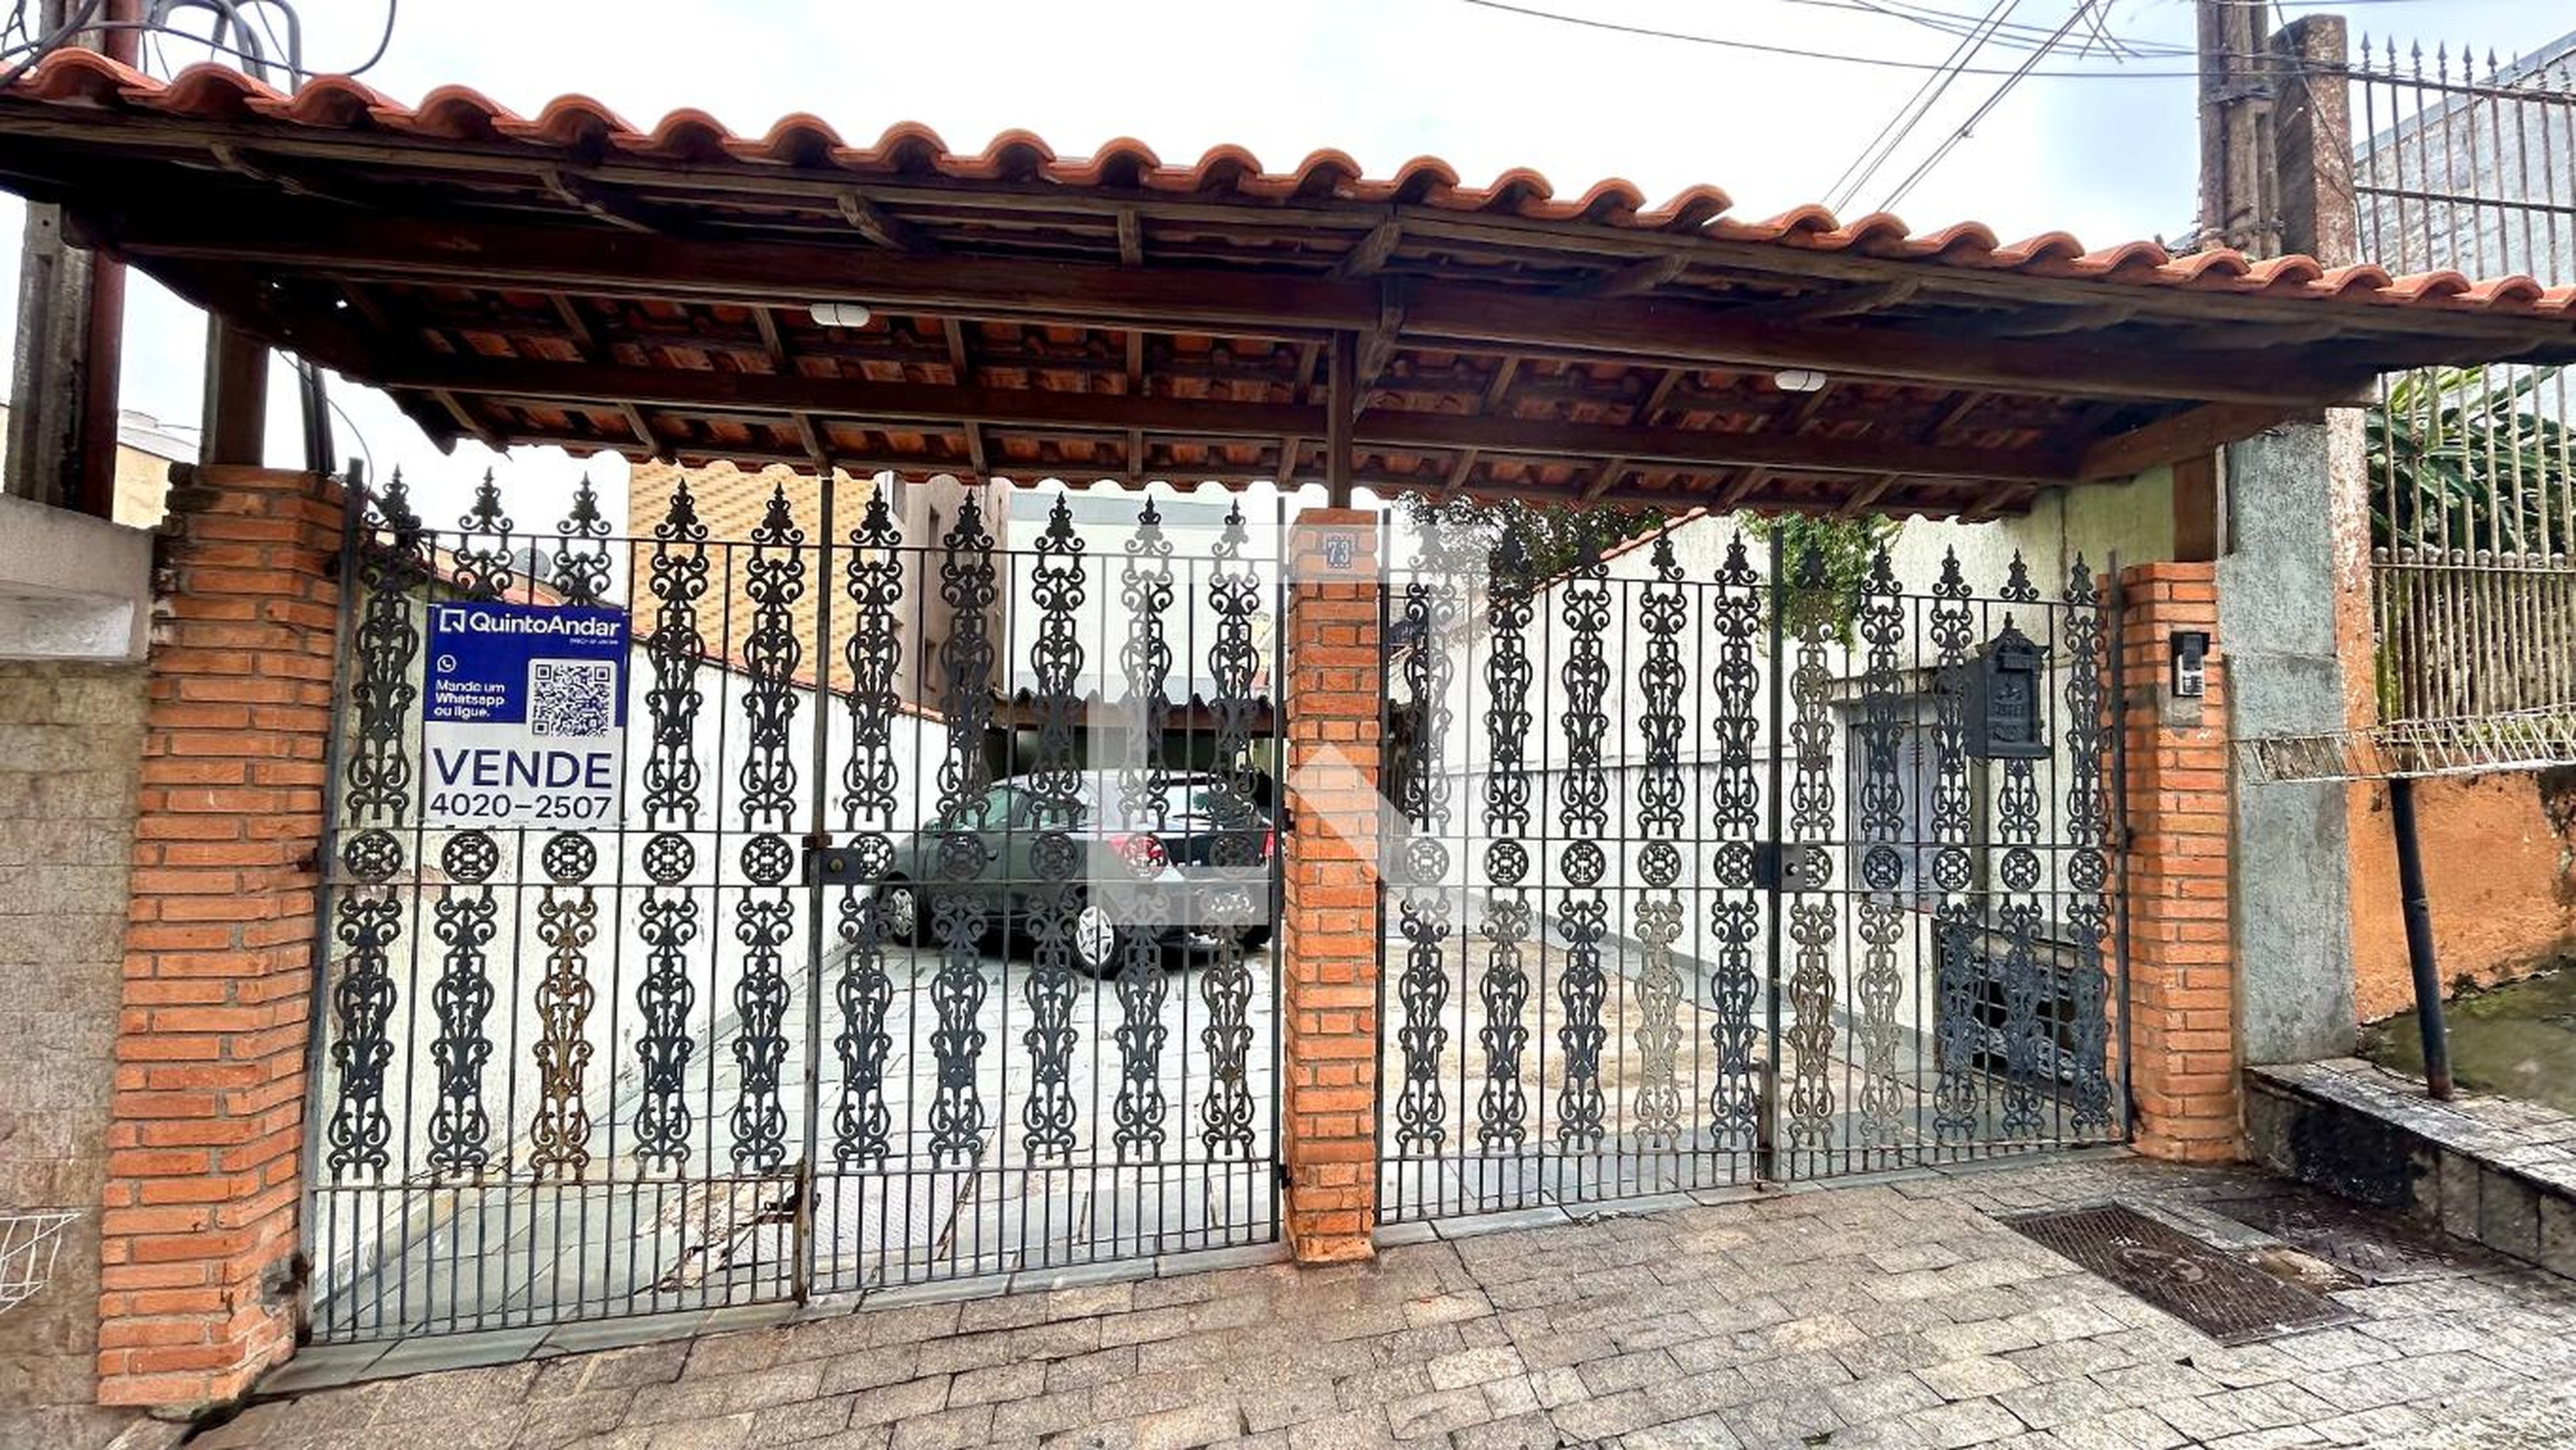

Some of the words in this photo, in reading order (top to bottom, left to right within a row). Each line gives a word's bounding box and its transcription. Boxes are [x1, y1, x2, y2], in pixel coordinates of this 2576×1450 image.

[1328, 540, 1349, 563] 73
[470, 611, 621, 637] QuintoAndar
[484, 683, 505, 692] um
[435, 692, 505, 707] Whatsapp
[434, 707, 452, 717] ou
[453, 706, 490, 720] ligue.
[433, 747, 612, 789] VENDE
[430, 792, 612, 819] 4020-2507
